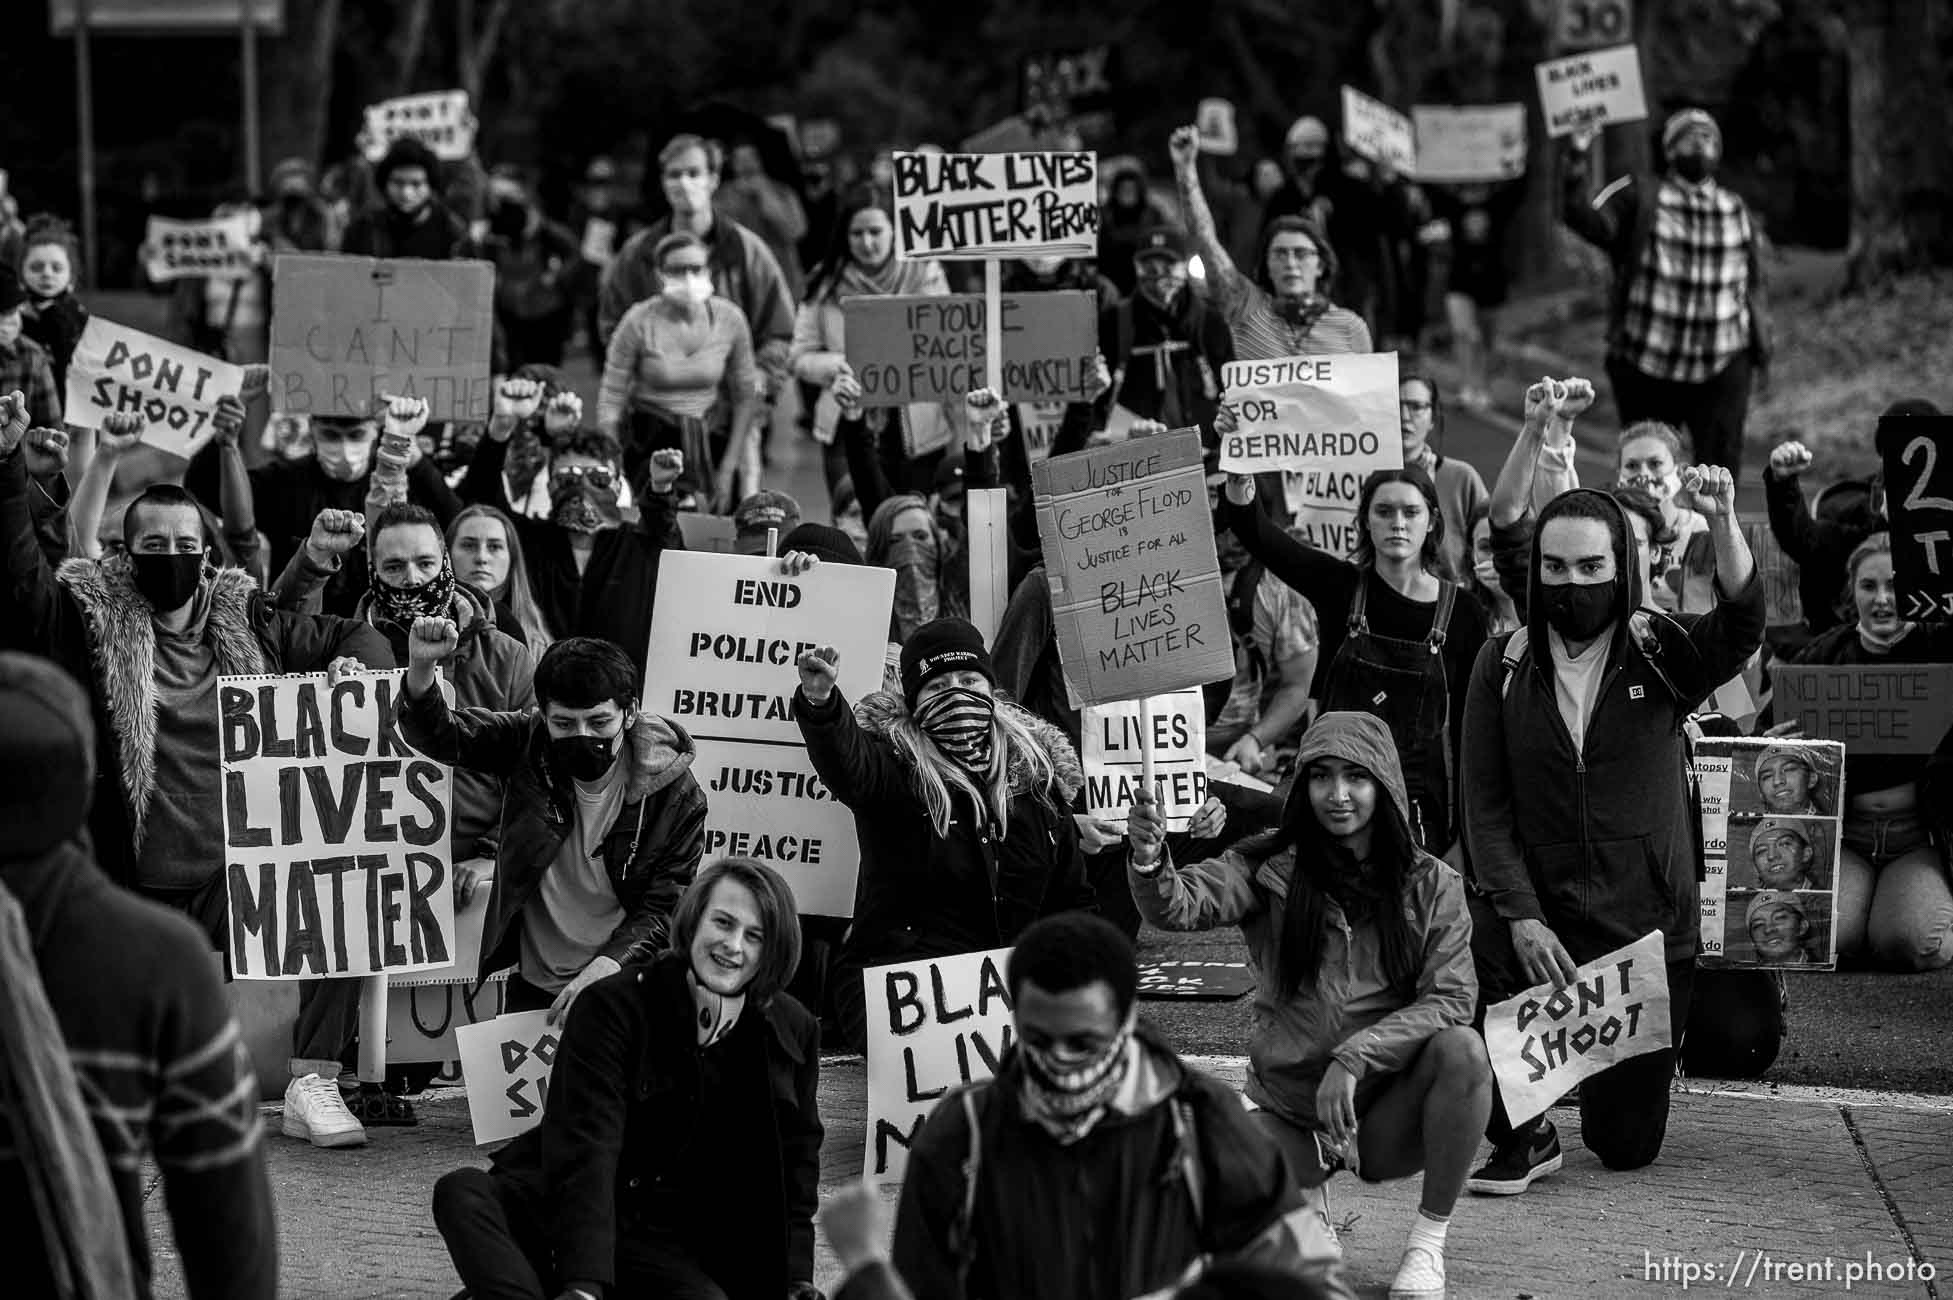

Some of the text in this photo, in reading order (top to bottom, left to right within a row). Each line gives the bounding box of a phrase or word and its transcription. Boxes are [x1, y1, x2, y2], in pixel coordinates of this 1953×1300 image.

[896, 154, 1093, 197] BLACK LIVES
[907, 304, 931, 331] IF
[861, 363, 900, 395] GO
[908, 363, 986, 398] FUCK
[1225, 360, 1331, 389] JUSTICE
[91, 377, 209, 439] SHOOT
[1228, 432, 1379, 458] BERNARDO
[1072, 455, 1161, 492] JUSTICE
[1059, 487, 1193, 540] GEORGE FLOYD
[1078, 545, 1130, 570] JUSTICE
[1138, 538, 1162, 557] FOR
[734, 579, 802, 609] END
[1101, 569, 1185, 614] BLACK
[1114, 603, 1176, 641] LIVES
[1099, 623, 1205, 672] MATTER
[1827, 672, 1929, 701] JUSTICE
[220, 679, 415, 763] BLACK
[1828, 709, 1909, 740] PEACE
[225, 760, 446, 848] LIVES
[704, 830, 822, 864] PEACE
[227, 852, 450, 977] MATTER
[1520, 1002, 1643, 1083] SHOOT
